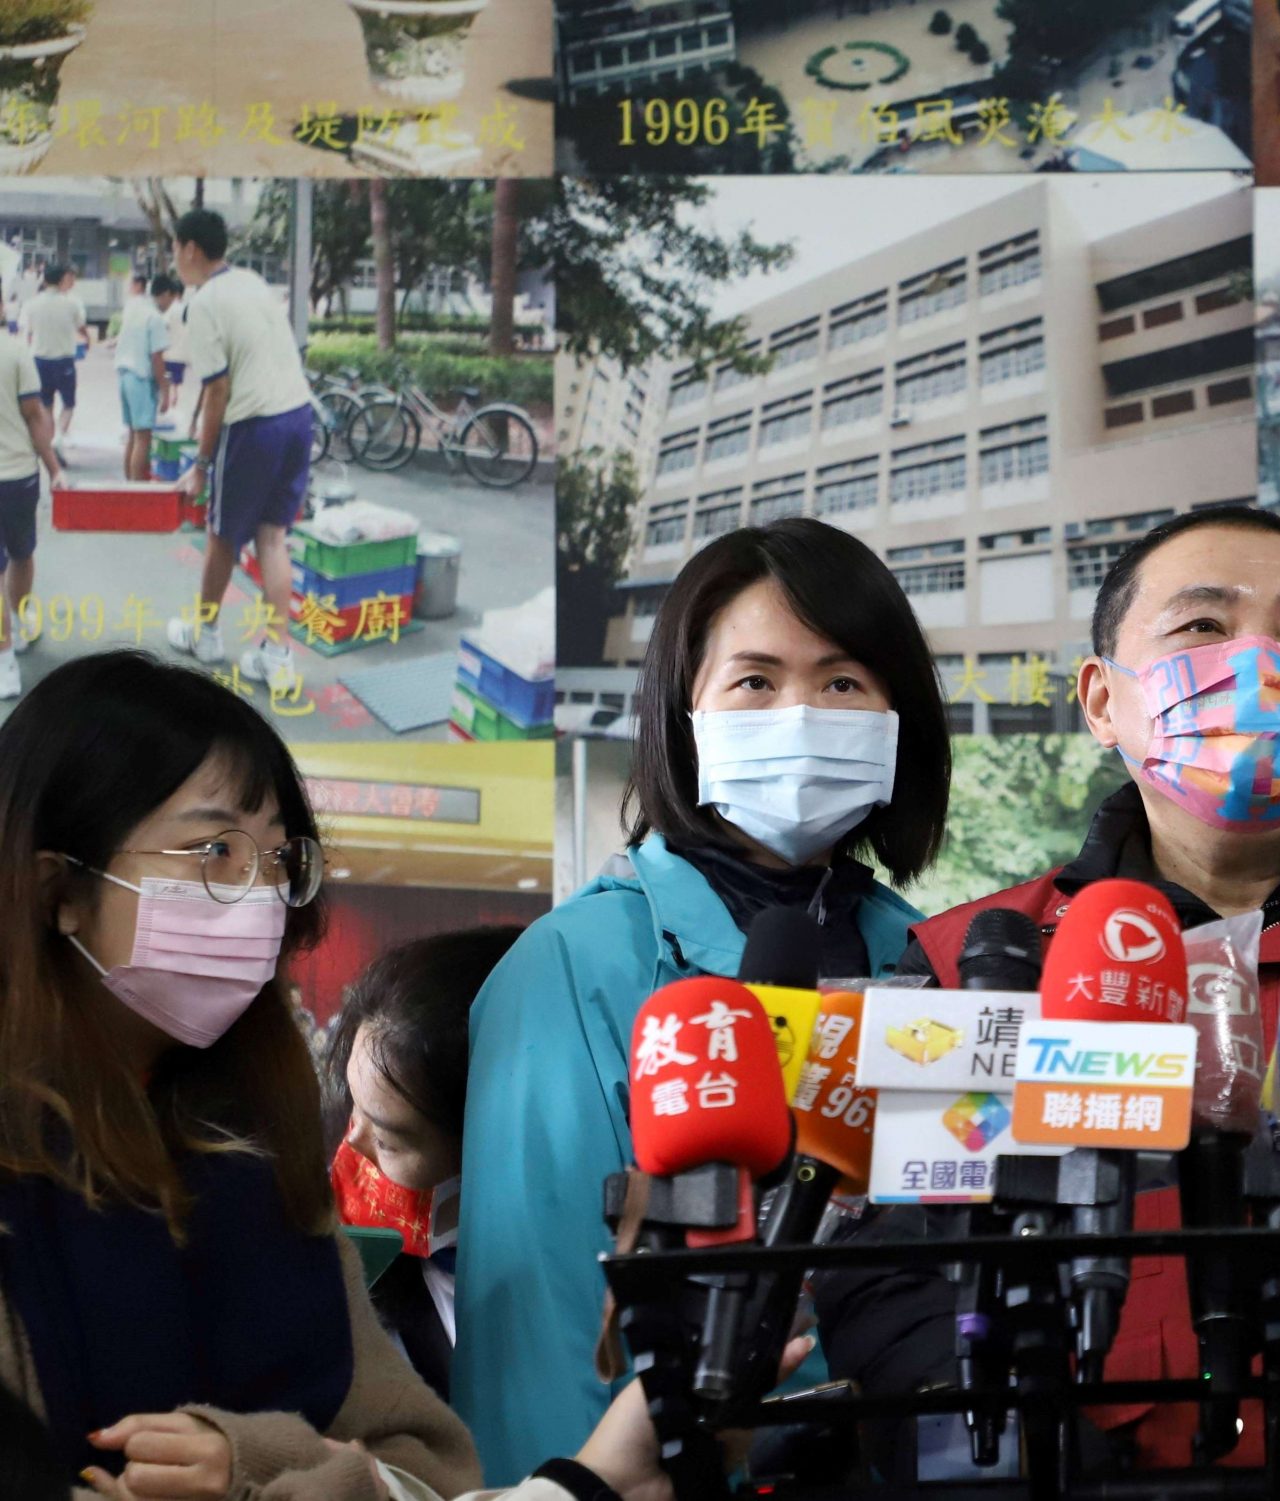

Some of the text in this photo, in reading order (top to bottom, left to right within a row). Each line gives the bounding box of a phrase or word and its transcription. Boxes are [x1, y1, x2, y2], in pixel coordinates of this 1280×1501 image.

[635, 1000, 753, 1080] 教育
[651, 1070, 738, 1117] 電台
[1042, 1091, 1164, 1133] 聯播網
[902, 1160, 997, 1190] 全國電
